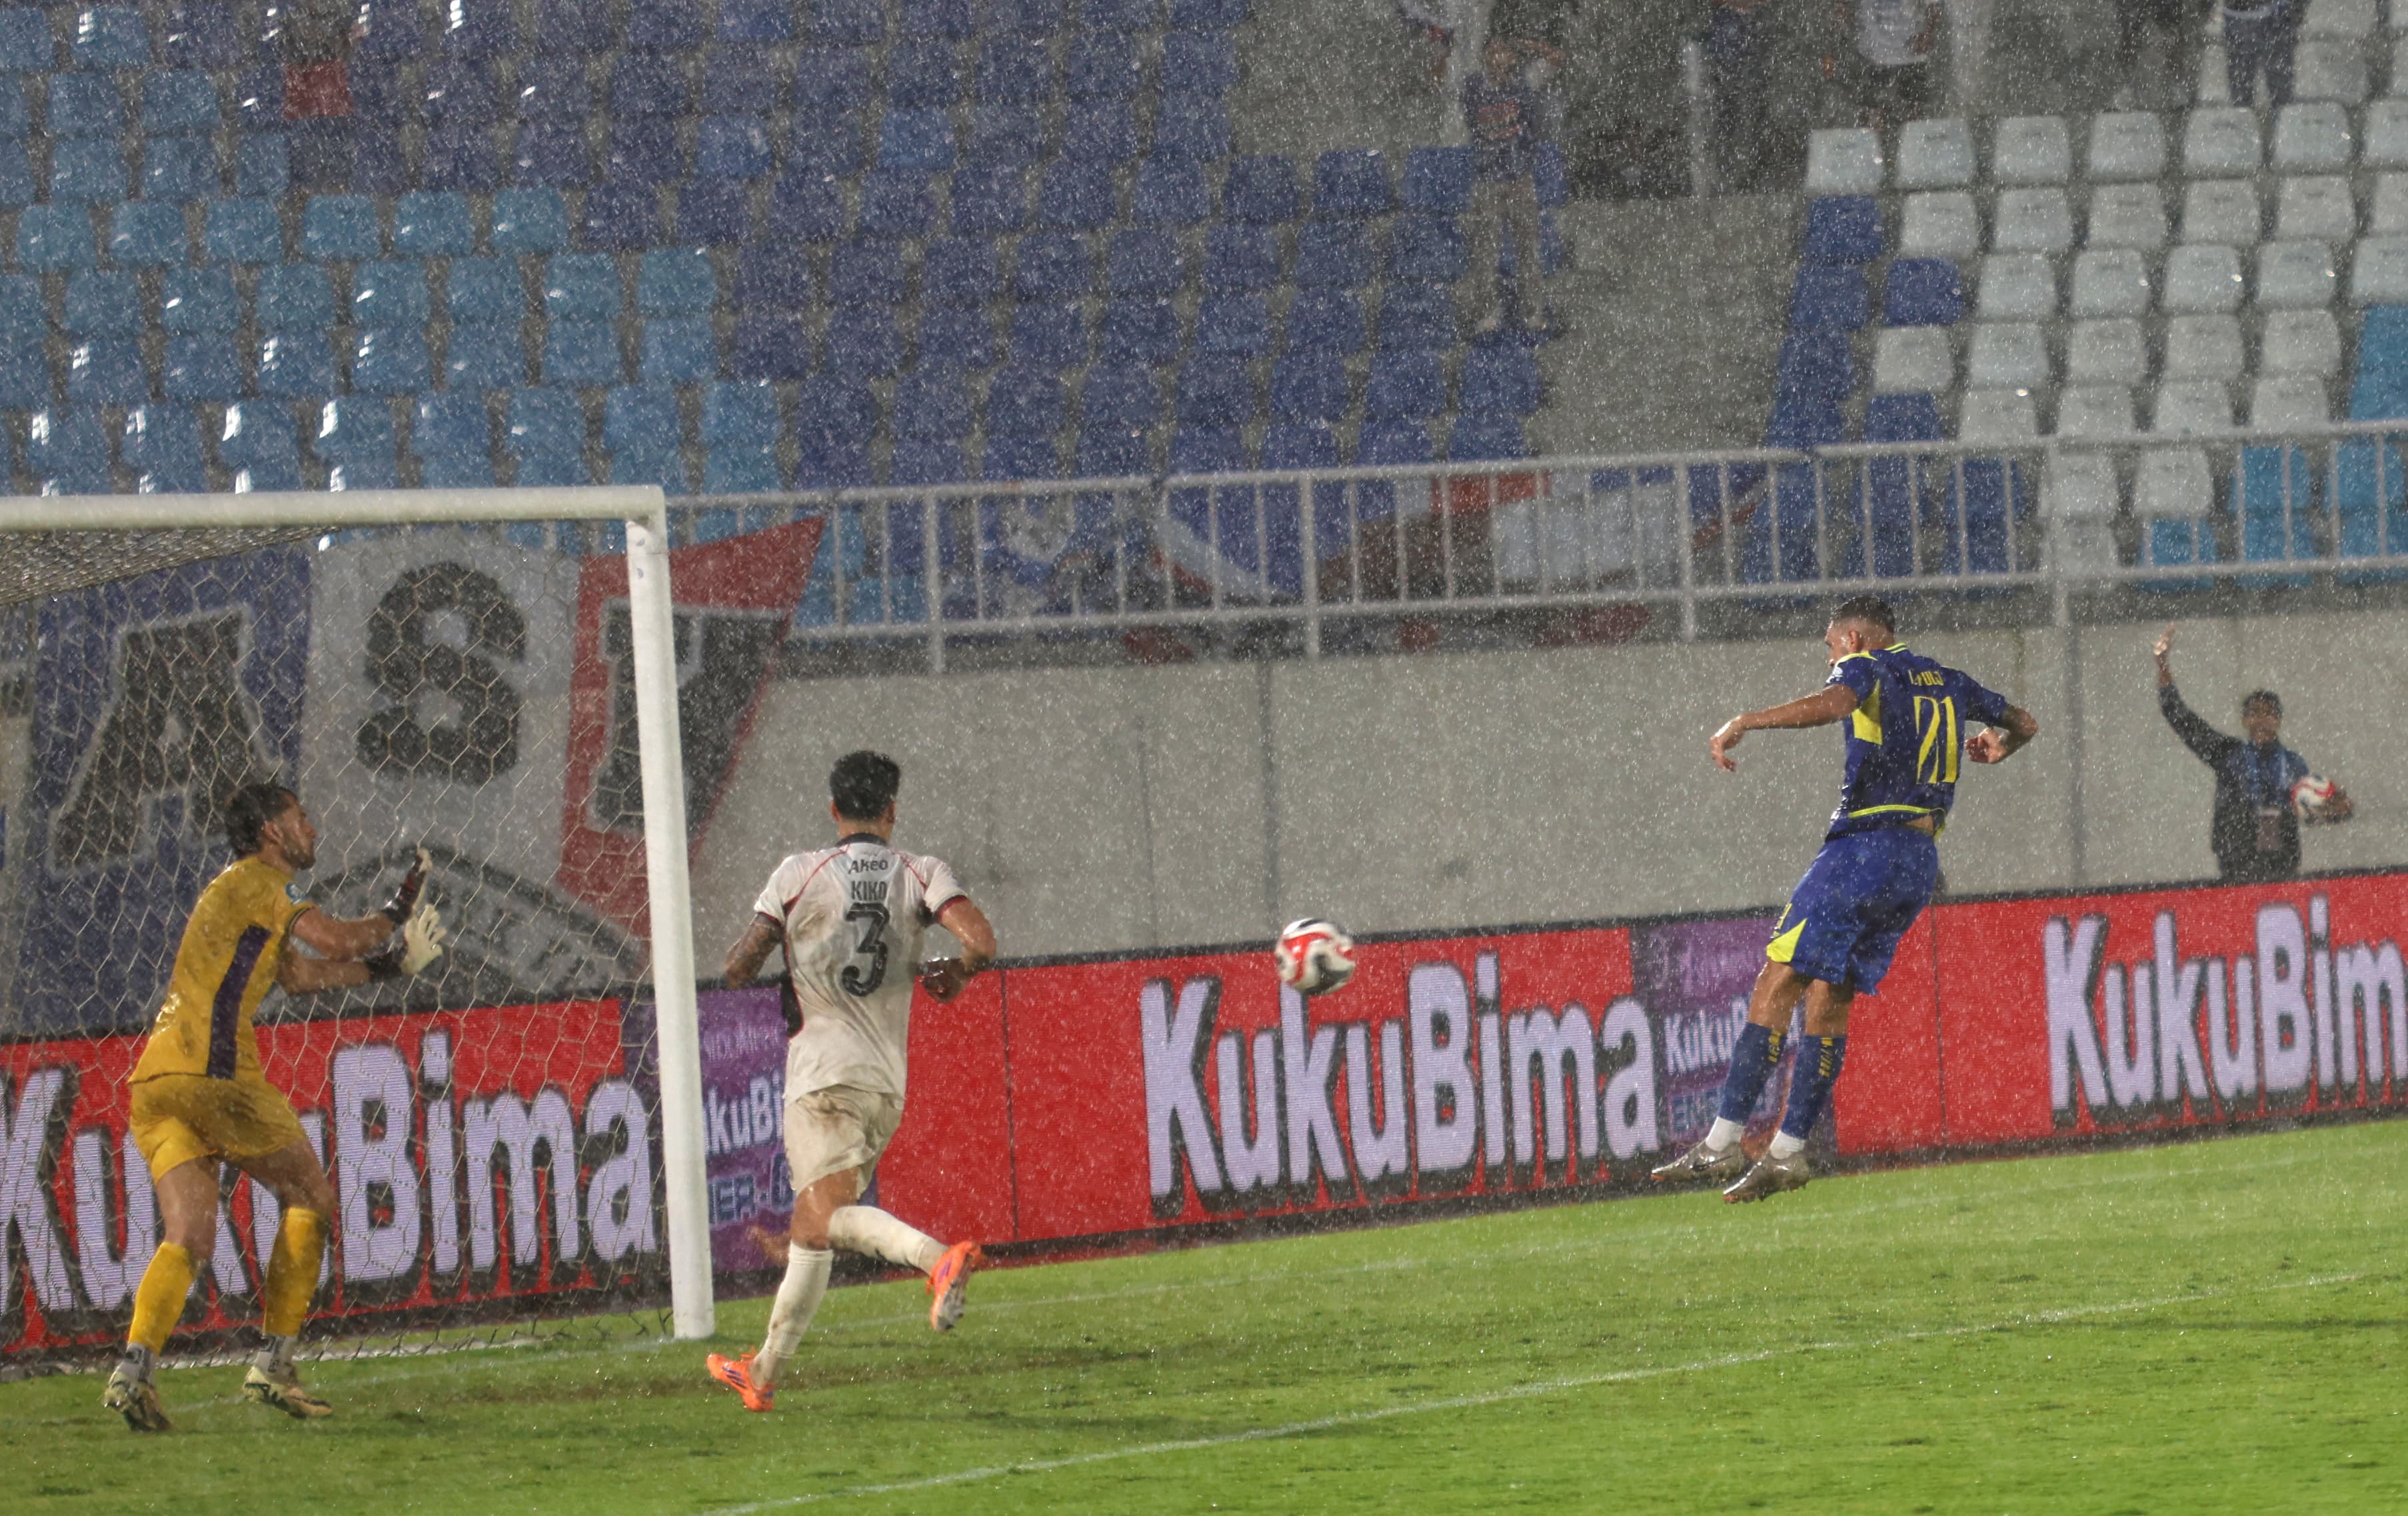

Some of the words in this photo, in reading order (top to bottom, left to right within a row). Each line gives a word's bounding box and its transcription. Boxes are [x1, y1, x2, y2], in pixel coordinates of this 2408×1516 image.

[1913, 696, 1957, 784] 21
[851, 880, 887, 901] KIKO
[842, 903, 890, 997] 3
[1140, 951, 1659, 1198] KukuBima
